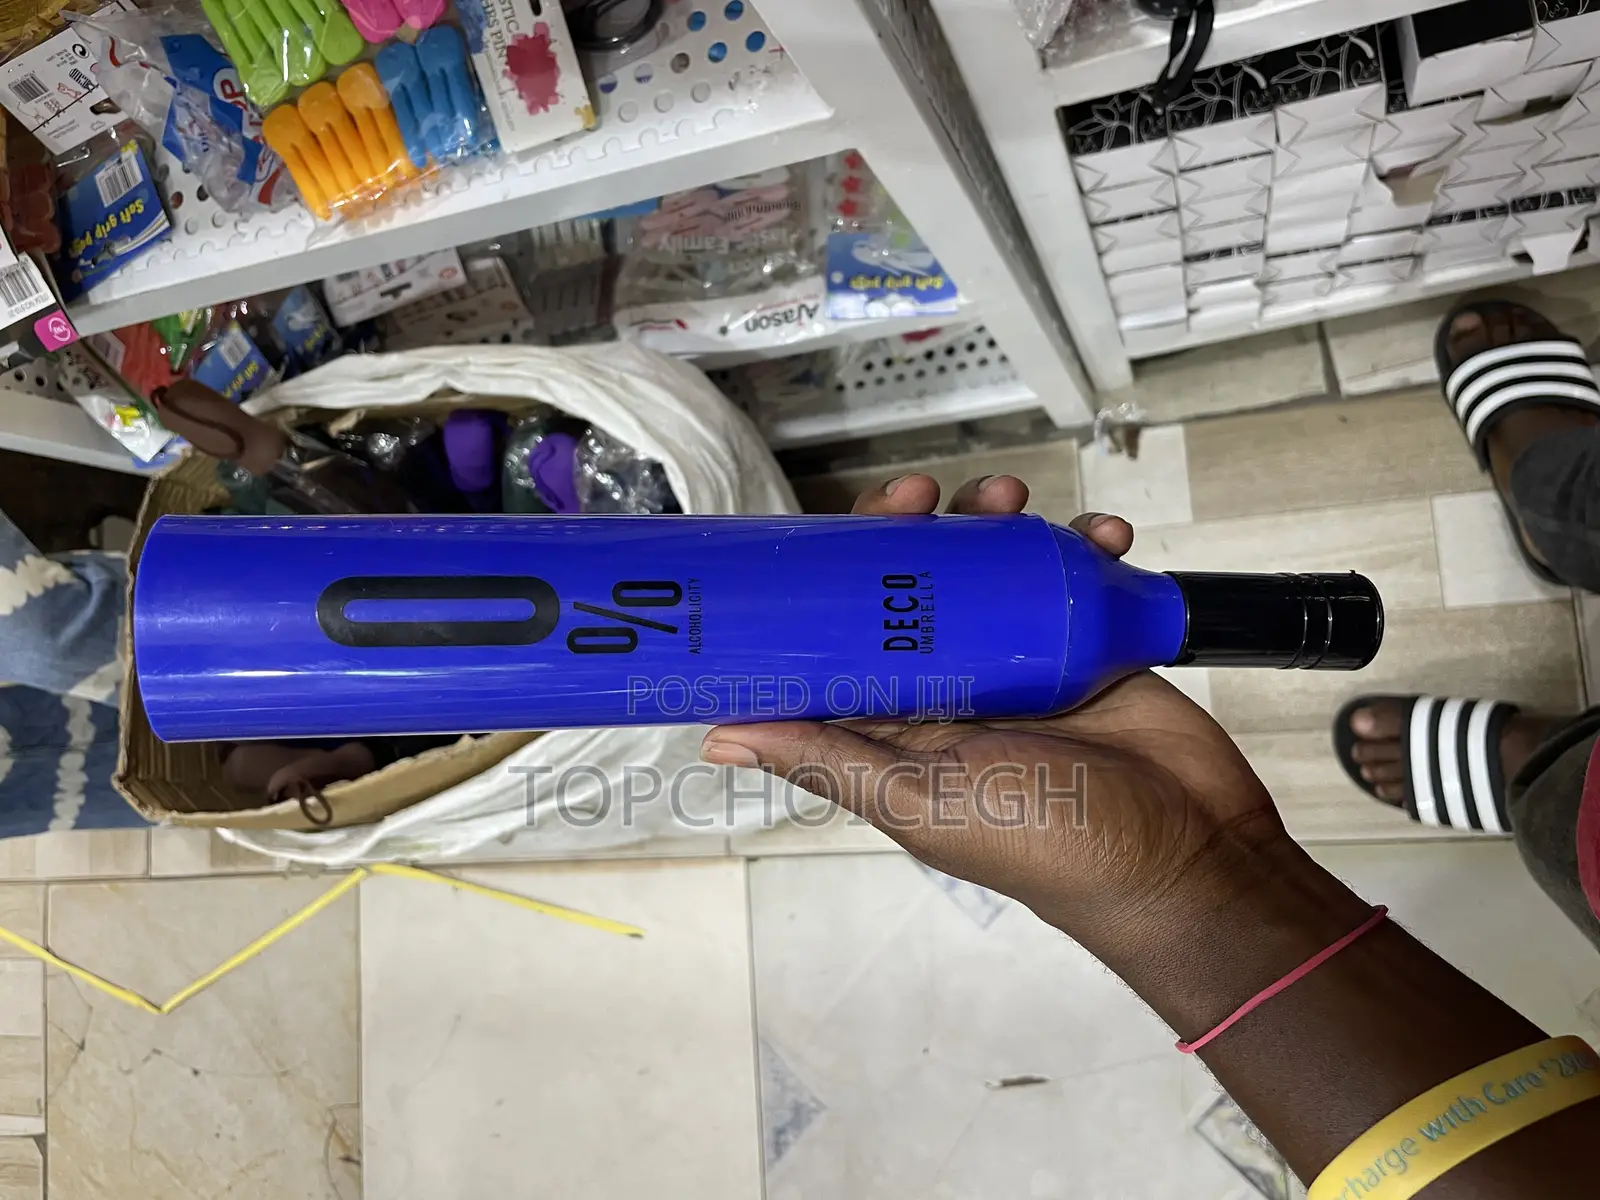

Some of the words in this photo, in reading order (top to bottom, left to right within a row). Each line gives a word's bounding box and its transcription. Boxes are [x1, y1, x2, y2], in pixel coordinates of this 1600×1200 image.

[95, 213, 118, 238] grip
[120, 198, 144, 224] Soft
[687, 577, 702, 654] ALCOHOLICITY
[881, 573, 919, 652] DECO
[918, 570, 935, 654] UMBRELLA
[1419, 1094, 1488, 1142] with
